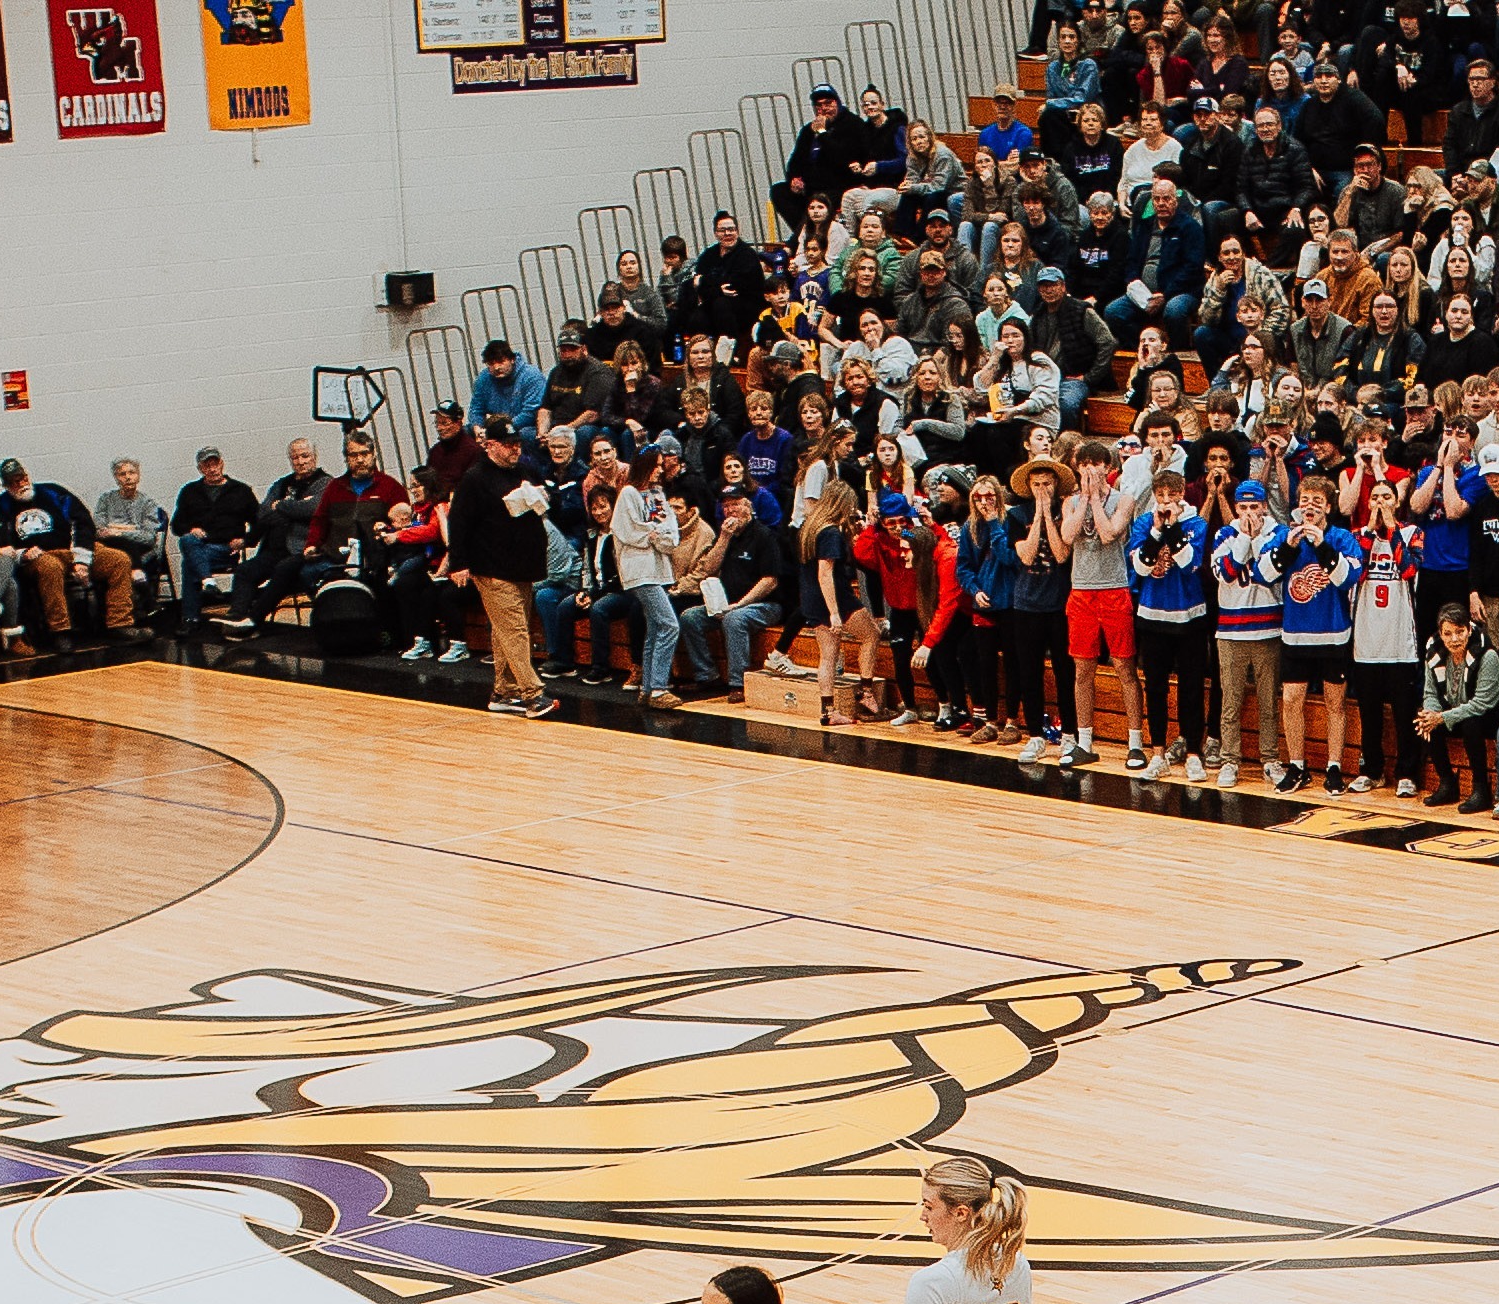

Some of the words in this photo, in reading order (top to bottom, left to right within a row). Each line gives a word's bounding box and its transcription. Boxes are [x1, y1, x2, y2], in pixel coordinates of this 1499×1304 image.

[453, 56, 508, 85] Donated
[508, 53, 528, 87] by
[58, 91, 163, 127] CARDINALS
[227, 85, 290, 120] NIMRODS
[1375, 585, 1389, 610] 9
